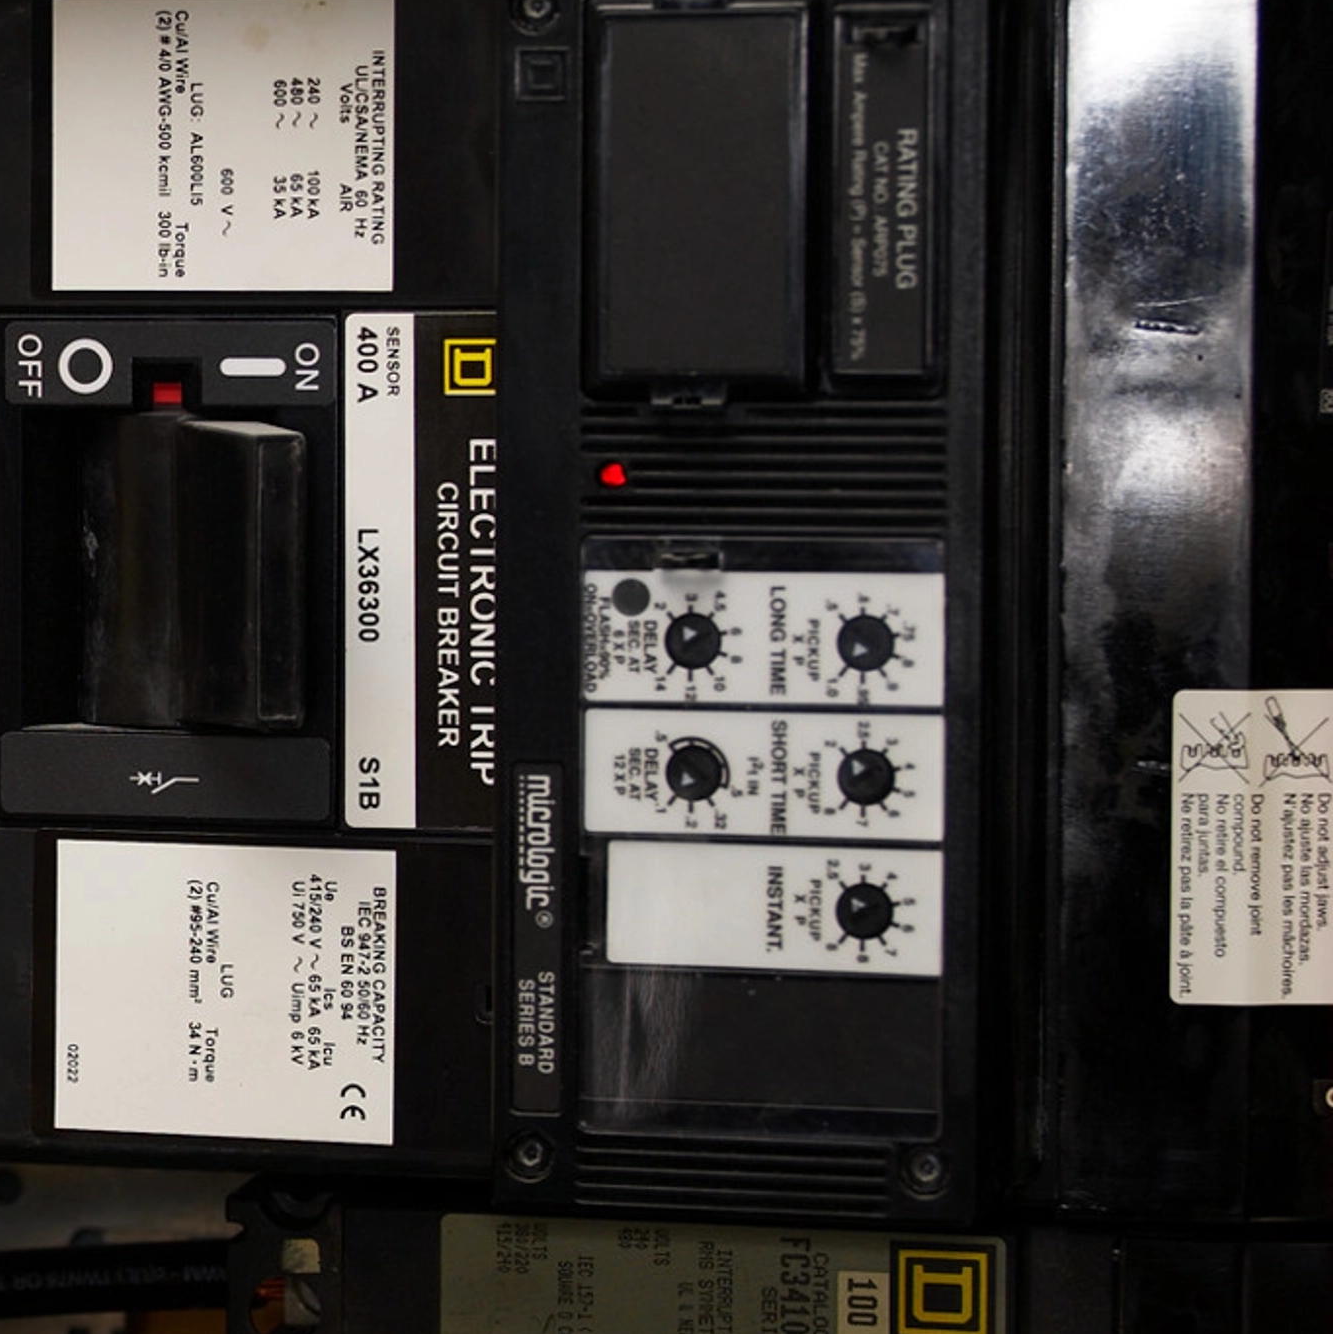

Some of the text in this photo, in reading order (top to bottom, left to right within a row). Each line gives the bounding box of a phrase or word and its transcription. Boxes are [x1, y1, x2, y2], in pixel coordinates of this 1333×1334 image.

[155, 10, 173, 278] (2) 4/0 AWG-500 kcmil 300 lb-in
[172, 9, 190, 278] Cu/Al Wire Torque
[189, 81, 203, 123] LUG:
[339, 82, 354, 212] Volts AIR
[371, 49, 386, 245] INTERRUPTING RATING
[354, 65, 370, 238] UL/CSA/NEMA 60 Hz
[895, 128, 919, 290] RATING PLUG
[17, 334, 43, 398] OFF
[294, 342, 320, 391] ON
[385, 326, 401, 396] SENSOR
[356, 326, 381, 811] 400 A LX36300 S1B
[437, 482, 460, 747] CIRCUIT BREAKER
[469, 438, 497, 785] ELECTRONIC TRIP
[643, 620, 658, 674] DELAY
[769, 585, 787, 695] LONG TIME
[806, 618, 821, 682] PICKUP
[643, 747, 659, 802] DELAY
[770, 720, 788, 836] SHORT TIME
[806, 751, 821, 815] PICKUP
[1192, 792, 1212, 877] para juntas.
[1230, 792, 1246, 876] compound.
[1247, 793, 1265, 936] Do not remove joint
[1279, 792, 1298, 860] N'ajustez
[1313, 792, 1333, 932] Do not adjust jaws.
[766, 865, 784, 952] INSTANT.
[807, 878, 823, 942] PICKUP
[1212, 793, 1230, 958] No retire el compuesto
[1280, 864, 1294, 892] pas
[1282, 895, 1296, 917] les
[1296, 792, 1315, 965] No ajuste las mordazas.
[202, 881, 220, 1083] Cu/Al Wire Torque
[219, 963, 235, 999] LUG
[340, 926, 356, 1021] BS EN 60 94
[356, 901, 373, 1046] IEC 947-2 50/60 Hz
[371, 886, 387, 1063] BREAKING CAPACITY
[66, 1043, 79, 1084] 02022
[518, 979, 536, 1066] SERIES B
[537, 971, 555, 1074] STANDARD
[846, 1277, 879, 1327] 100
